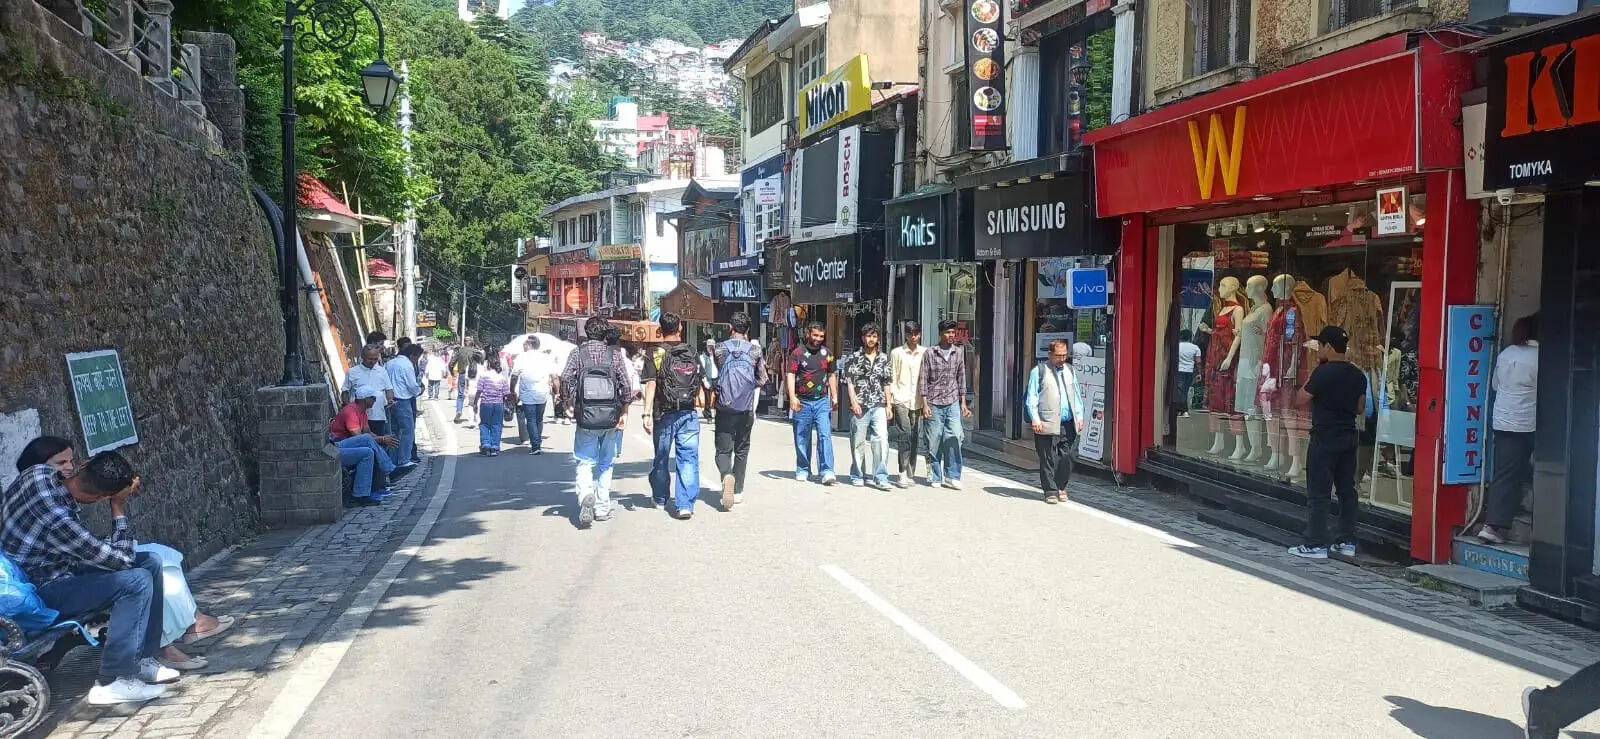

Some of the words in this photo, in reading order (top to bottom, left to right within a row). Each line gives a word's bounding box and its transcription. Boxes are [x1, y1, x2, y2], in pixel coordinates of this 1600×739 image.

[806, 80, 848, 131] Nikon
[843, 135, 851, 197] BOSCH
[1187, 105, 1247, 200] W
[1509, 159, 1553, 180] TOMYKA
[901, 215, 936, 247] Knits
[987, 201, 1066, 236] SAMSUNG
[794, 261, 814, 287] Sony
[816, 257, 848, 281] Center
[1074, 284, 1105, 294] vivo
[1465, 313, 1483, 467] COZYNET
[83, 413, 97, 436] KEEP
[97, 412, 107, 433] TO
[105, 409, 118, 429] THE
[116, 406, 130, 426] LEFT
